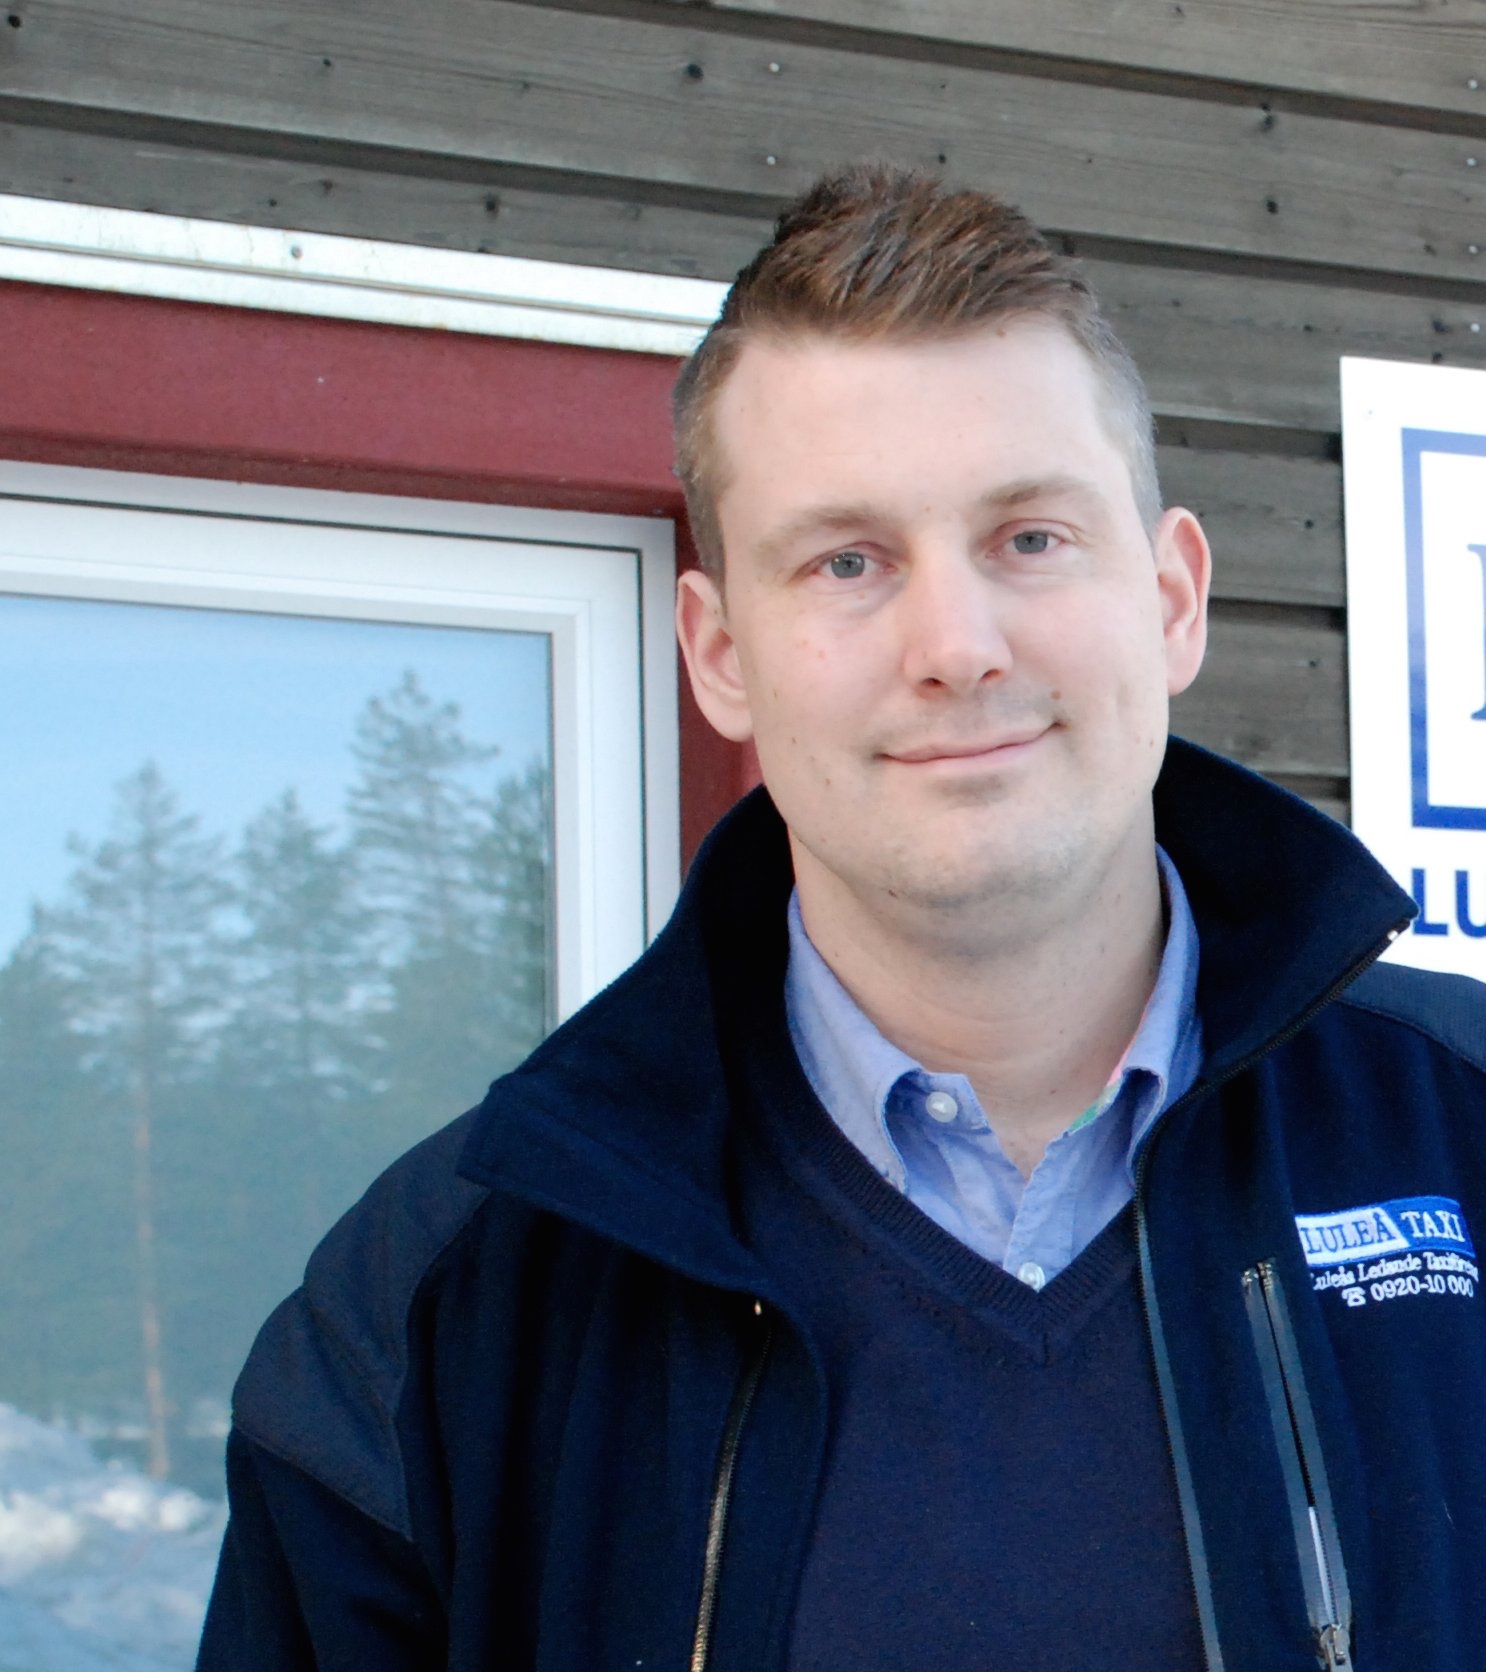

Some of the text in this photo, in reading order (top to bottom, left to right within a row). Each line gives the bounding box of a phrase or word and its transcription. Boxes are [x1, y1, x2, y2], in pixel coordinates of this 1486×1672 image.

[1300, 1210, 1466, 1254] LULEÅ TAXI
[1310, 1265, 1356, 1291] uleås
[1357, 1252, 1422, 1282] Ledande
[1370, 1273, 1474, 1302] 0920-10 000
